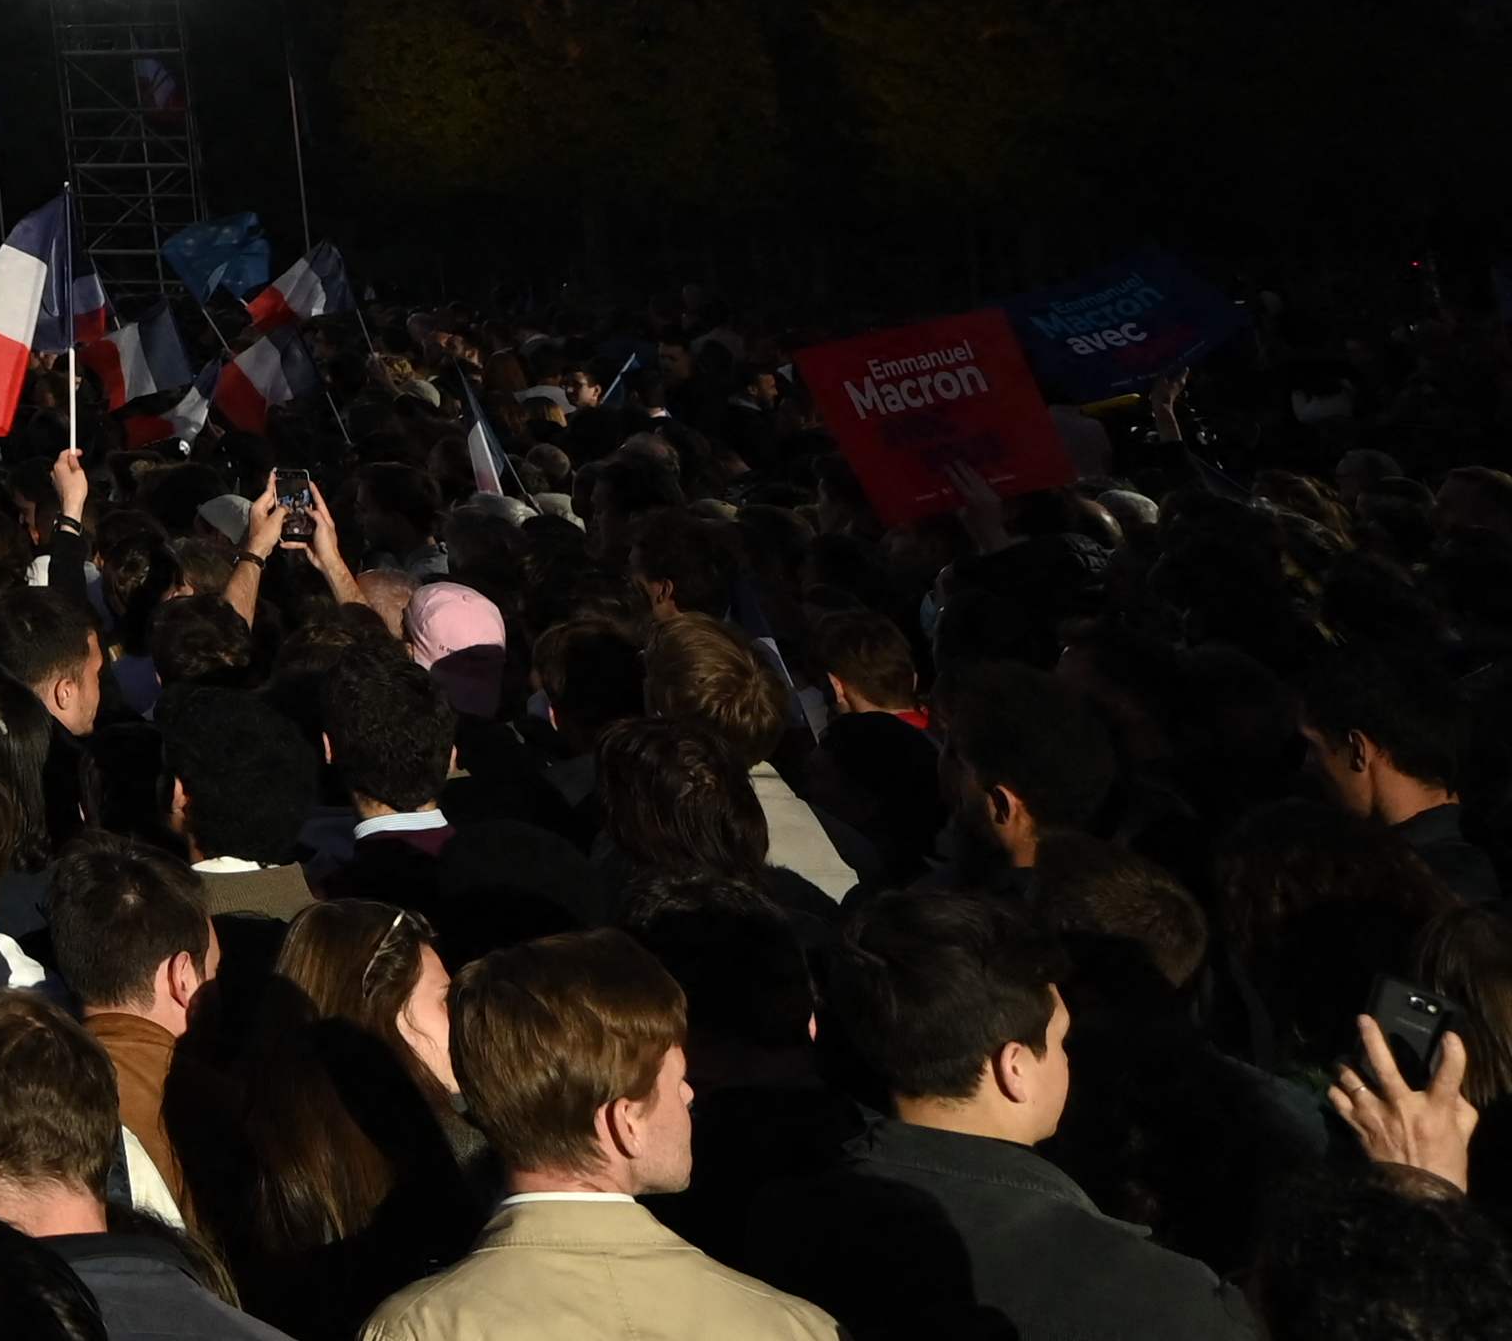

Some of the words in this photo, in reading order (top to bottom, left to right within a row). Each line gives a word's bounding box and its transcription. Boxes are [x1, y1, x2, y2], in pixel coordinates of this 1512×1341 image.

[1029, 285, 1164, 340] Macron
[1049, 270, 1146, 316] Emmanuel
[866, 338, 976, 381] Emmanuel
[1065, 322, 1148, 355] avec
[843, 365, 990, 420] Macron
